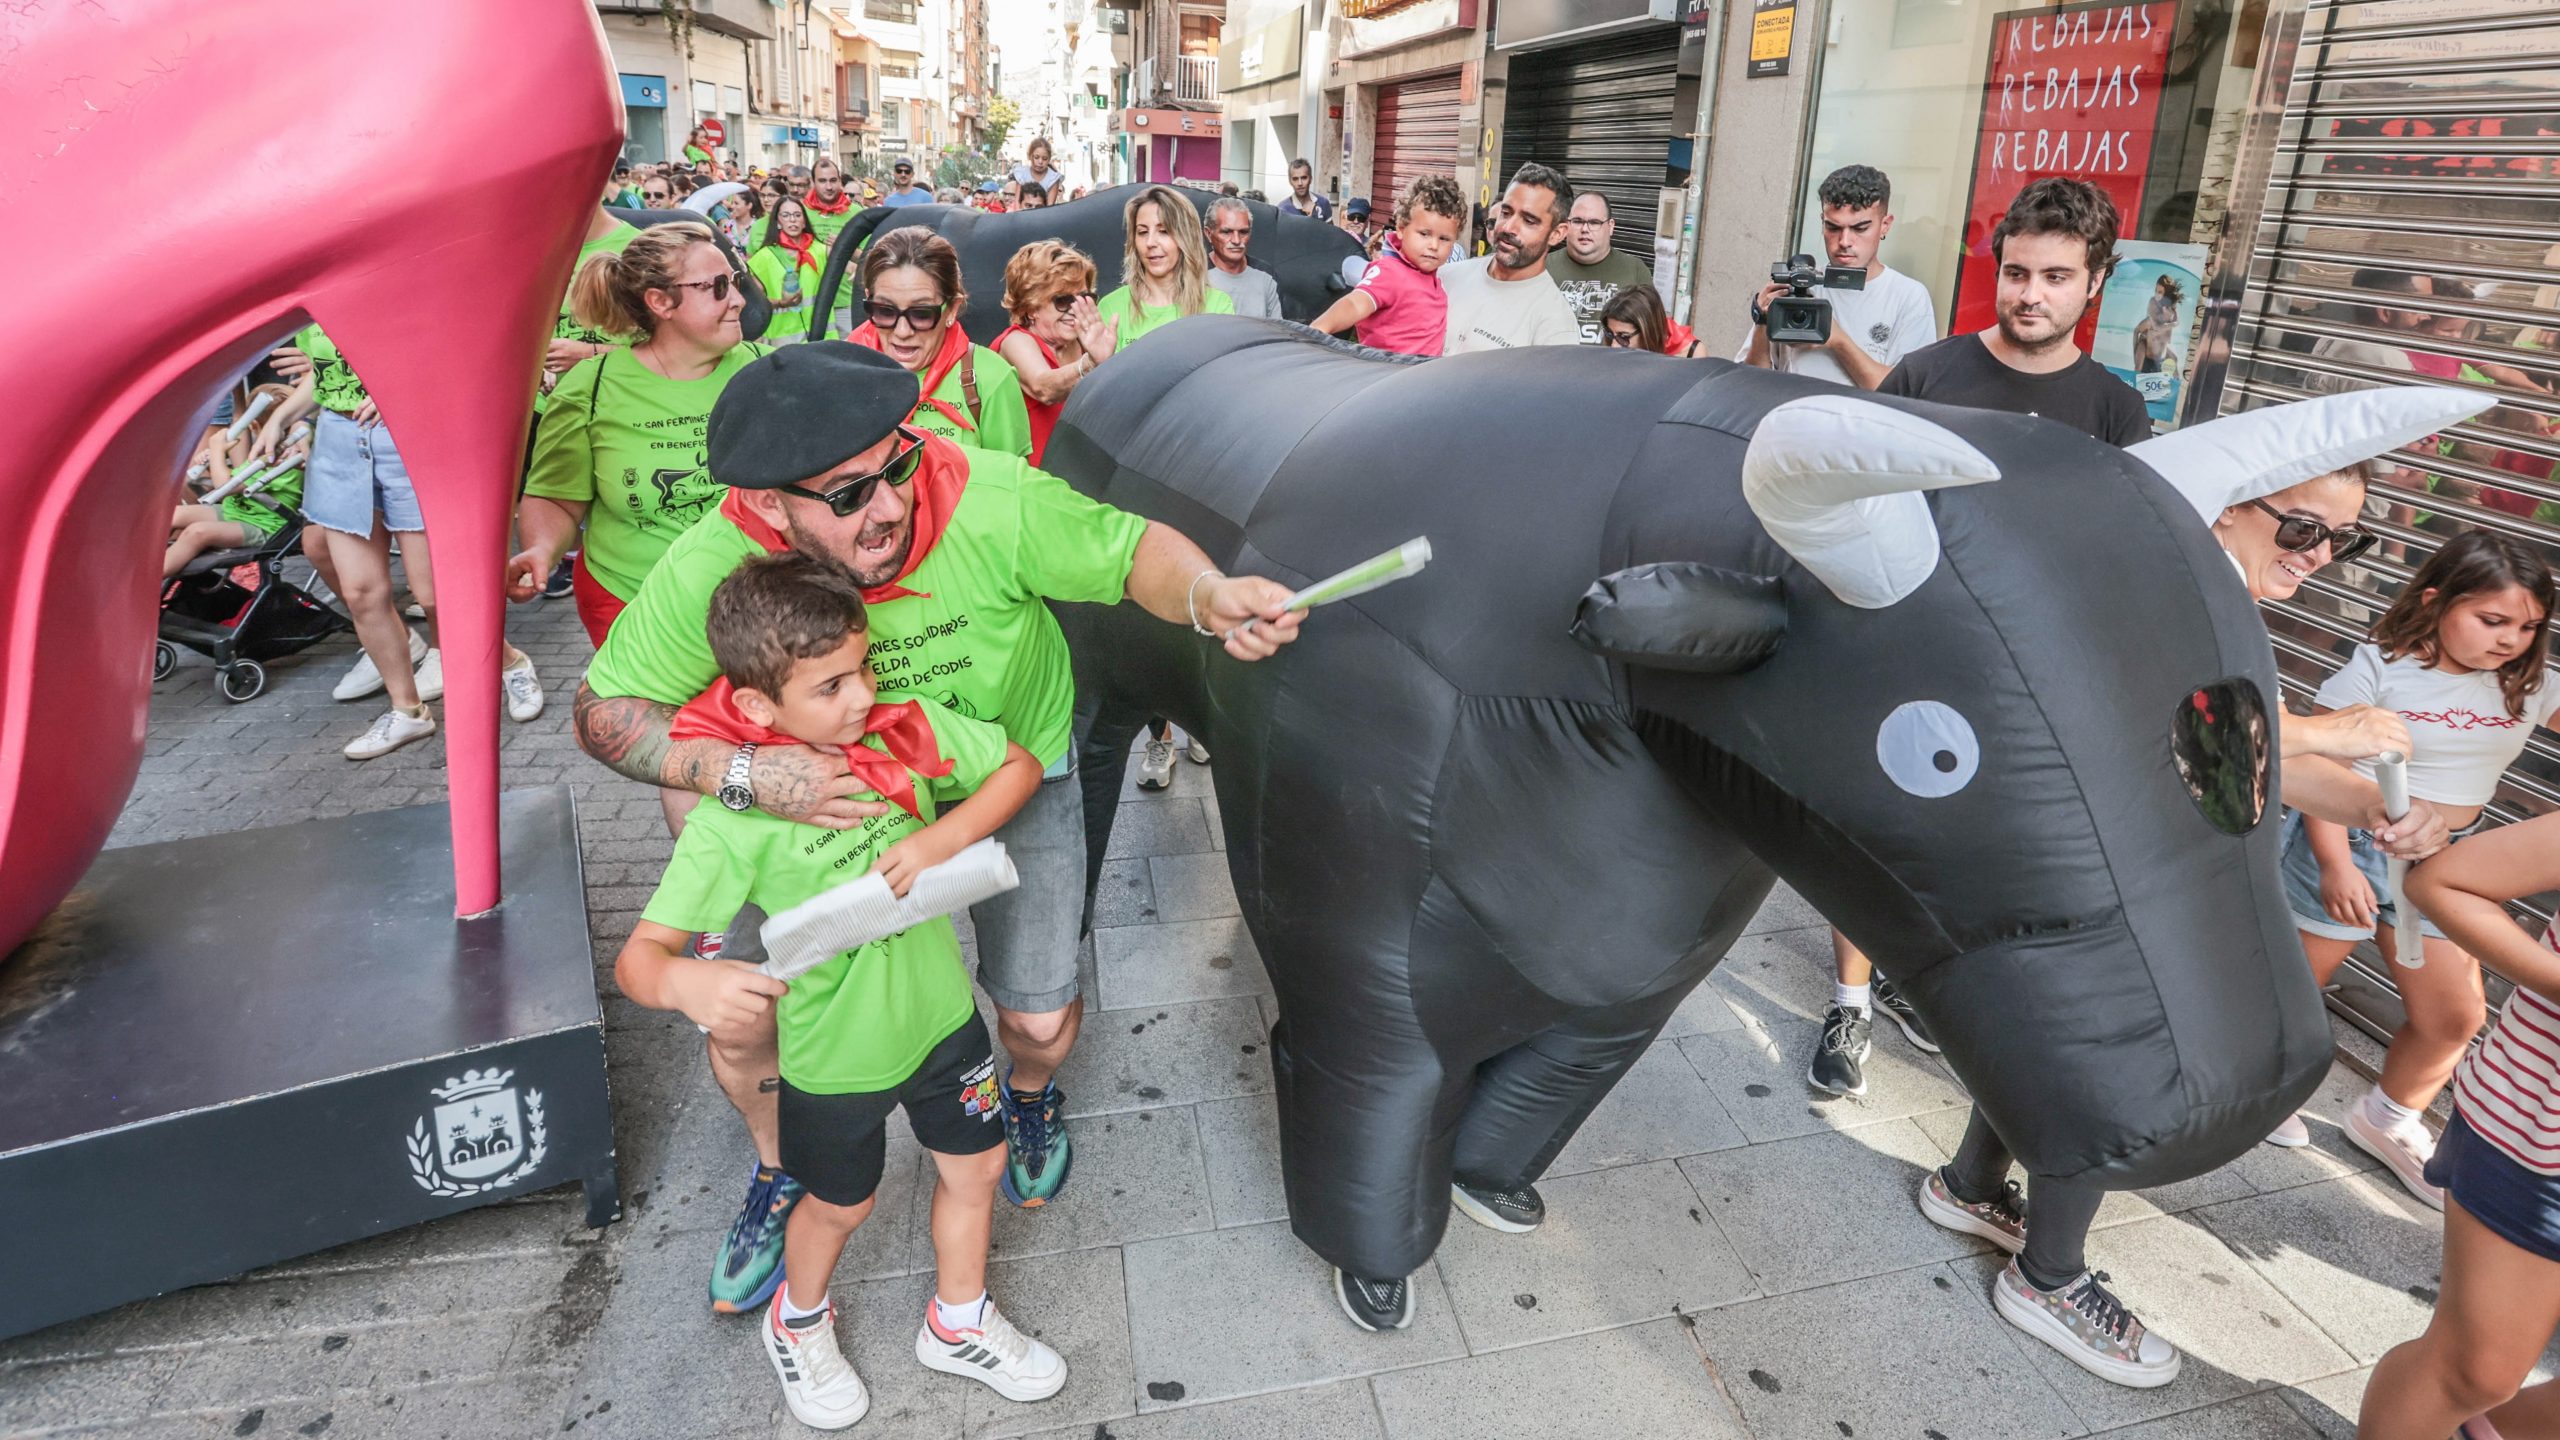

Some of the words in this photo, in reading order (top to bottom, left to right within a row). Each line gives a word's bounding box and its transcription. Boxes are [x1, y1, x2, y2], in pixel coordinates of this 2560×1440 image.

[1757, 16, 1790, 28] CONECTADA
[2001, 64, 2142, 113] REBAJAS
[1992, 128, 2131, 173] REBAJAS
[1480, 127, 1494, 208] ORO
[1315, 205, 1323, 219] 2
[2145, 381, 2163, 392] 50€
[645, 419, 664, 429] SAN
[693, 426, 707, 437] EL
[650, 442, 664, 450] EN
[667, 439, 707, 449] BENEFIC
[868, 638, 901, 656] INES
[872, 655, 911, 676] ELDA
[912, 670, 933, 686] DE
[931, 655, 973, 676] CODIS
[804, 844, 815, 856] IV
[815, 830, 837, 849] SAN
[834, 857, 848, 869] EN
